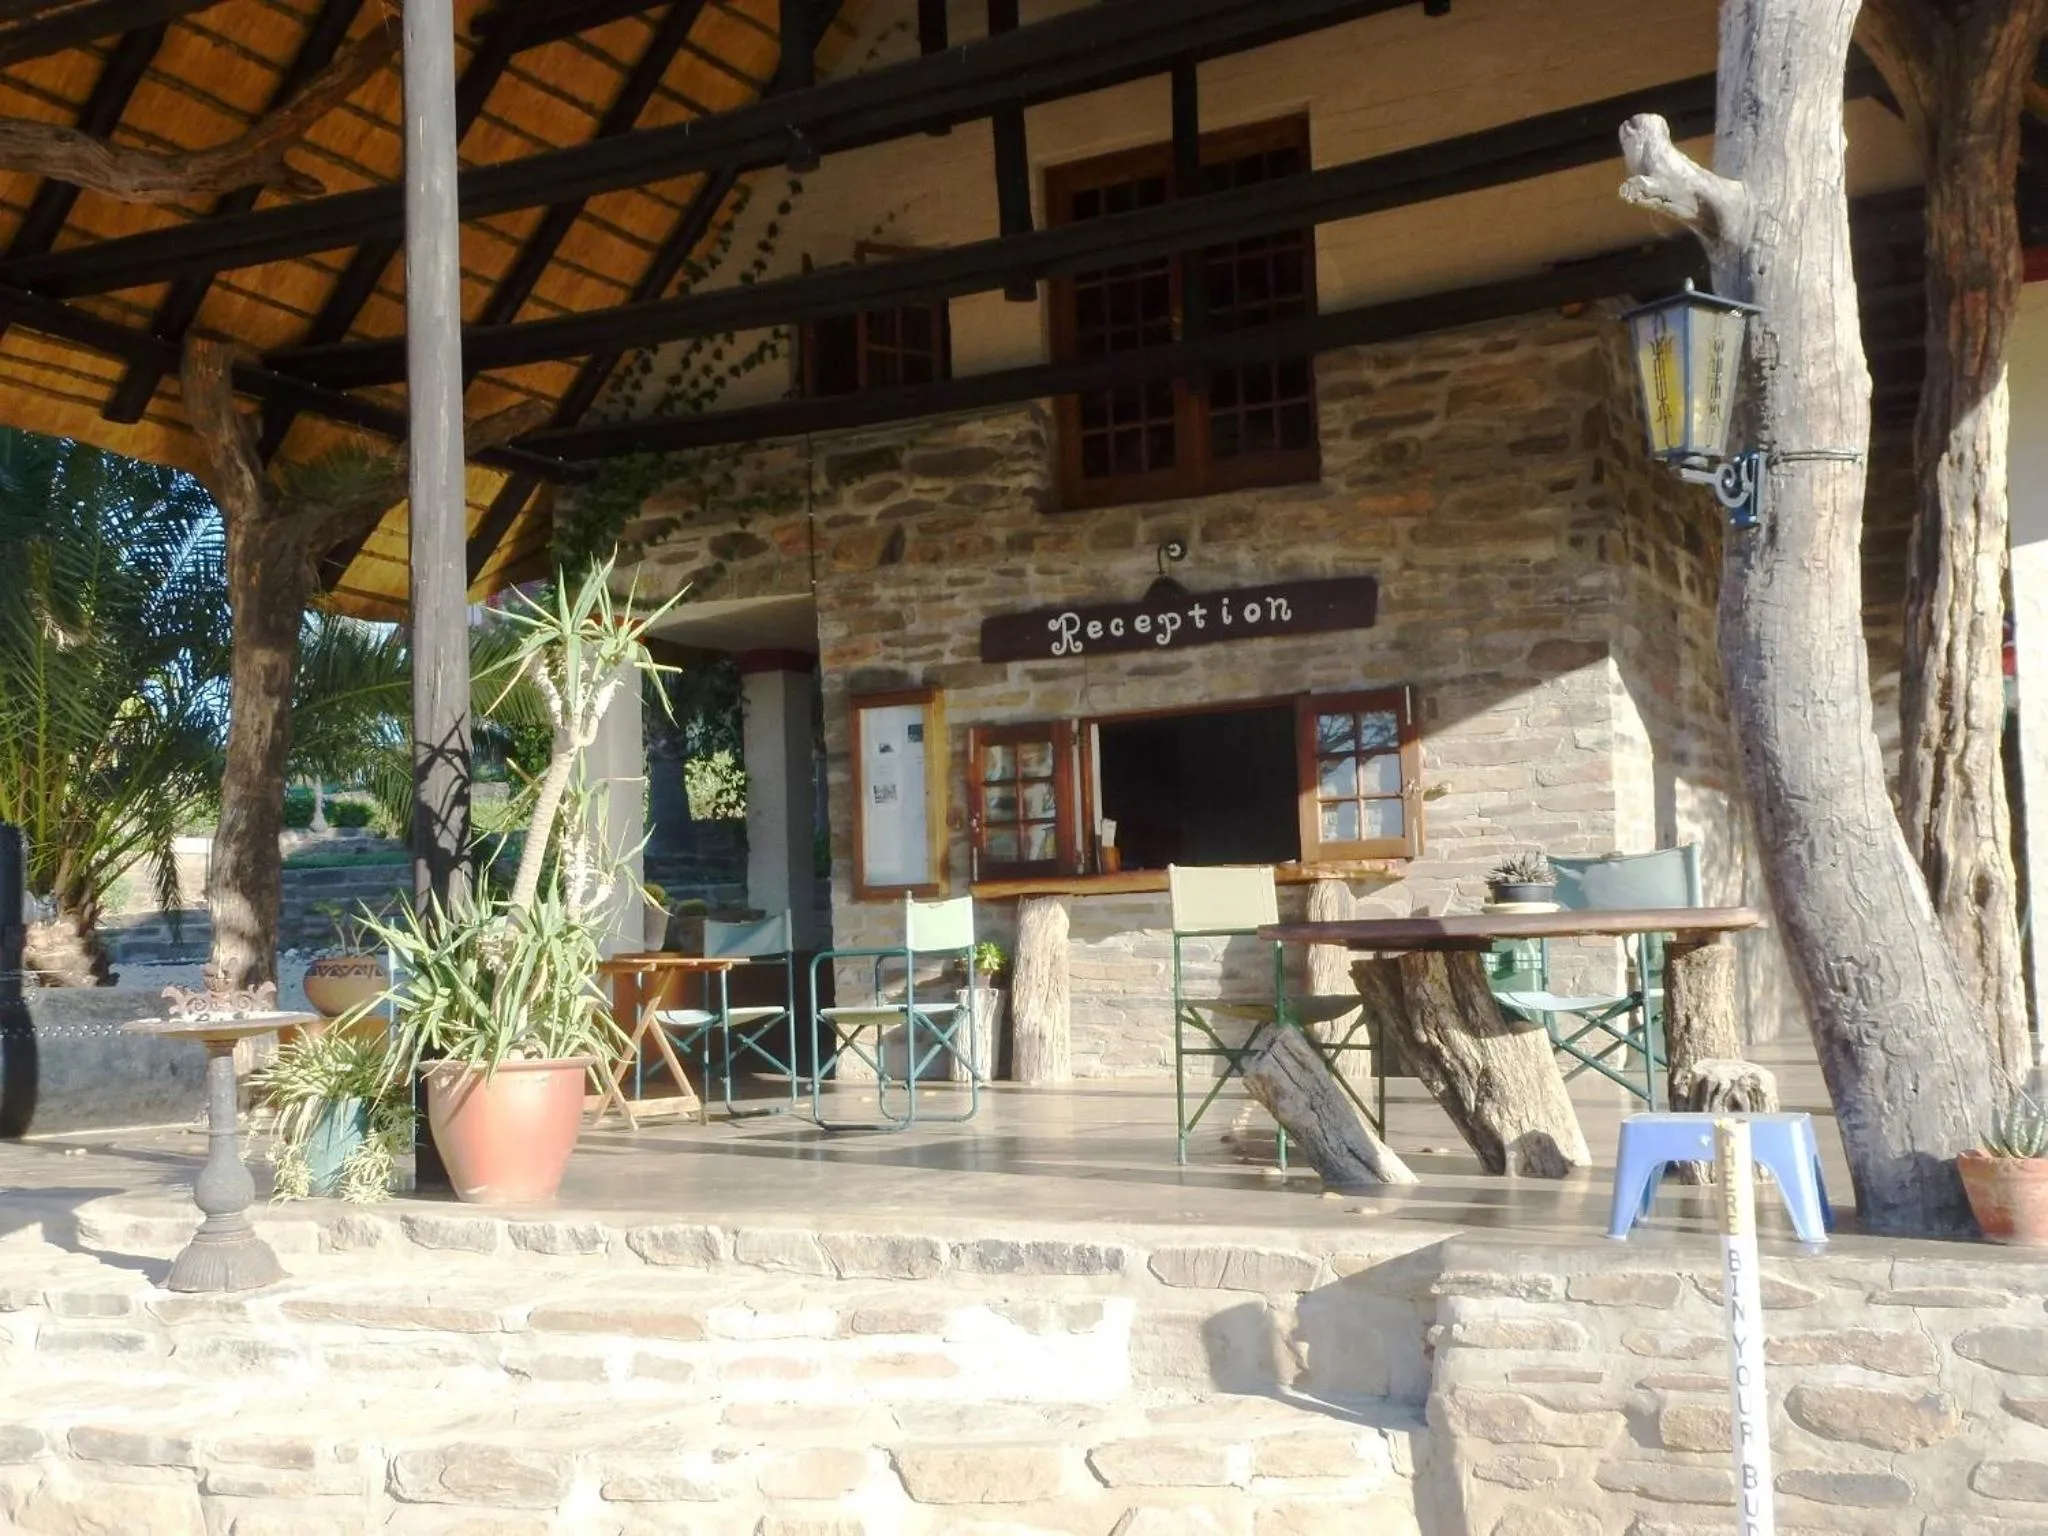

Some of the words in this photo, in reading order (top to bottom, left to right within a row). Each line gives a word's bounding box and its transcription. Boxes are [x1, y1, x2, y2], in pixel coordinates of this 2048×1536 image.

[1047, 597, 1293, 655] Reception
[1728, 1249, 1745, 1321] BIN
[1732, 1334, 1754, 1446] YOUR
